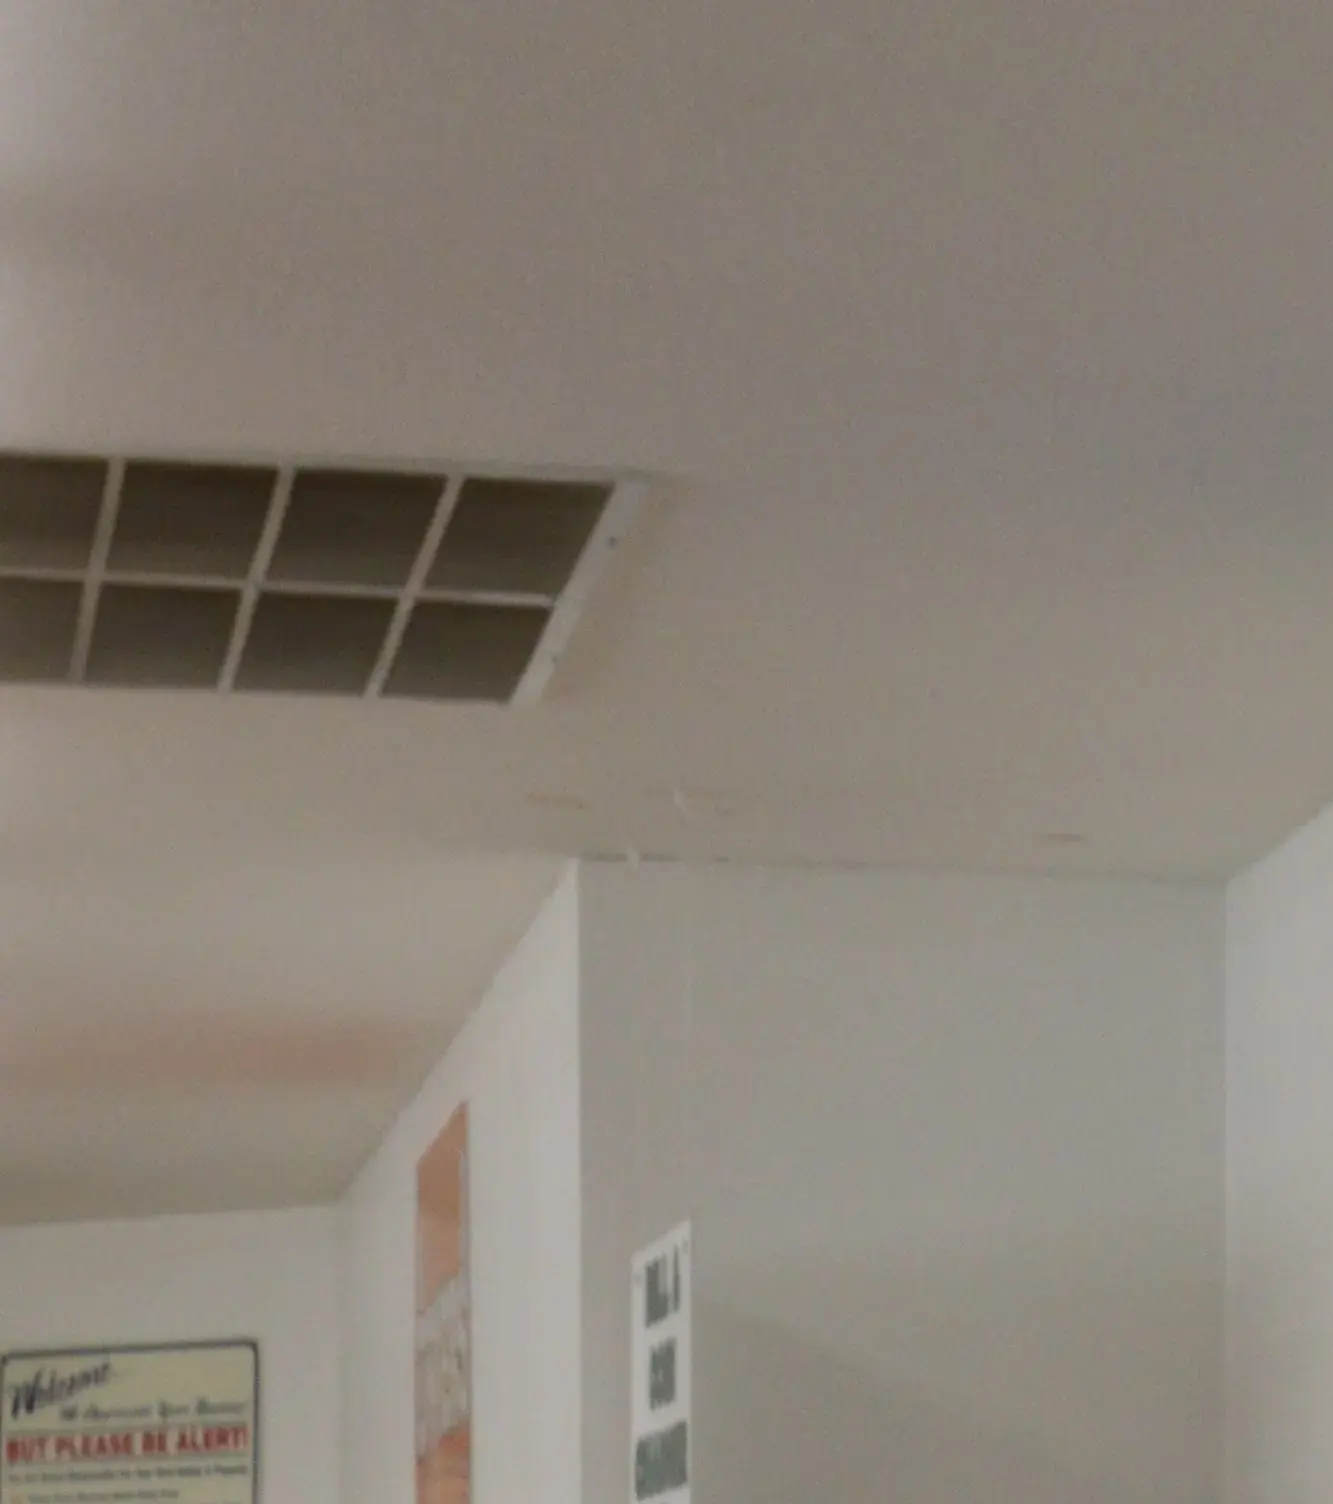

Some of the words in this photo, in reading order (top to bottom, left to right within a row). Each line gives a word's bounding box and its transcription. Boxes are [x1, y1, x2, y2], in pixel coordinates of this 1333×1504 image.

[6, 1432, 48, 1464] BUT
[54, 1431, 134, 1460] PLEASE
[141, 1430, 168, 1455] BE
[177, 1424, 249, 1454] ALERT!
